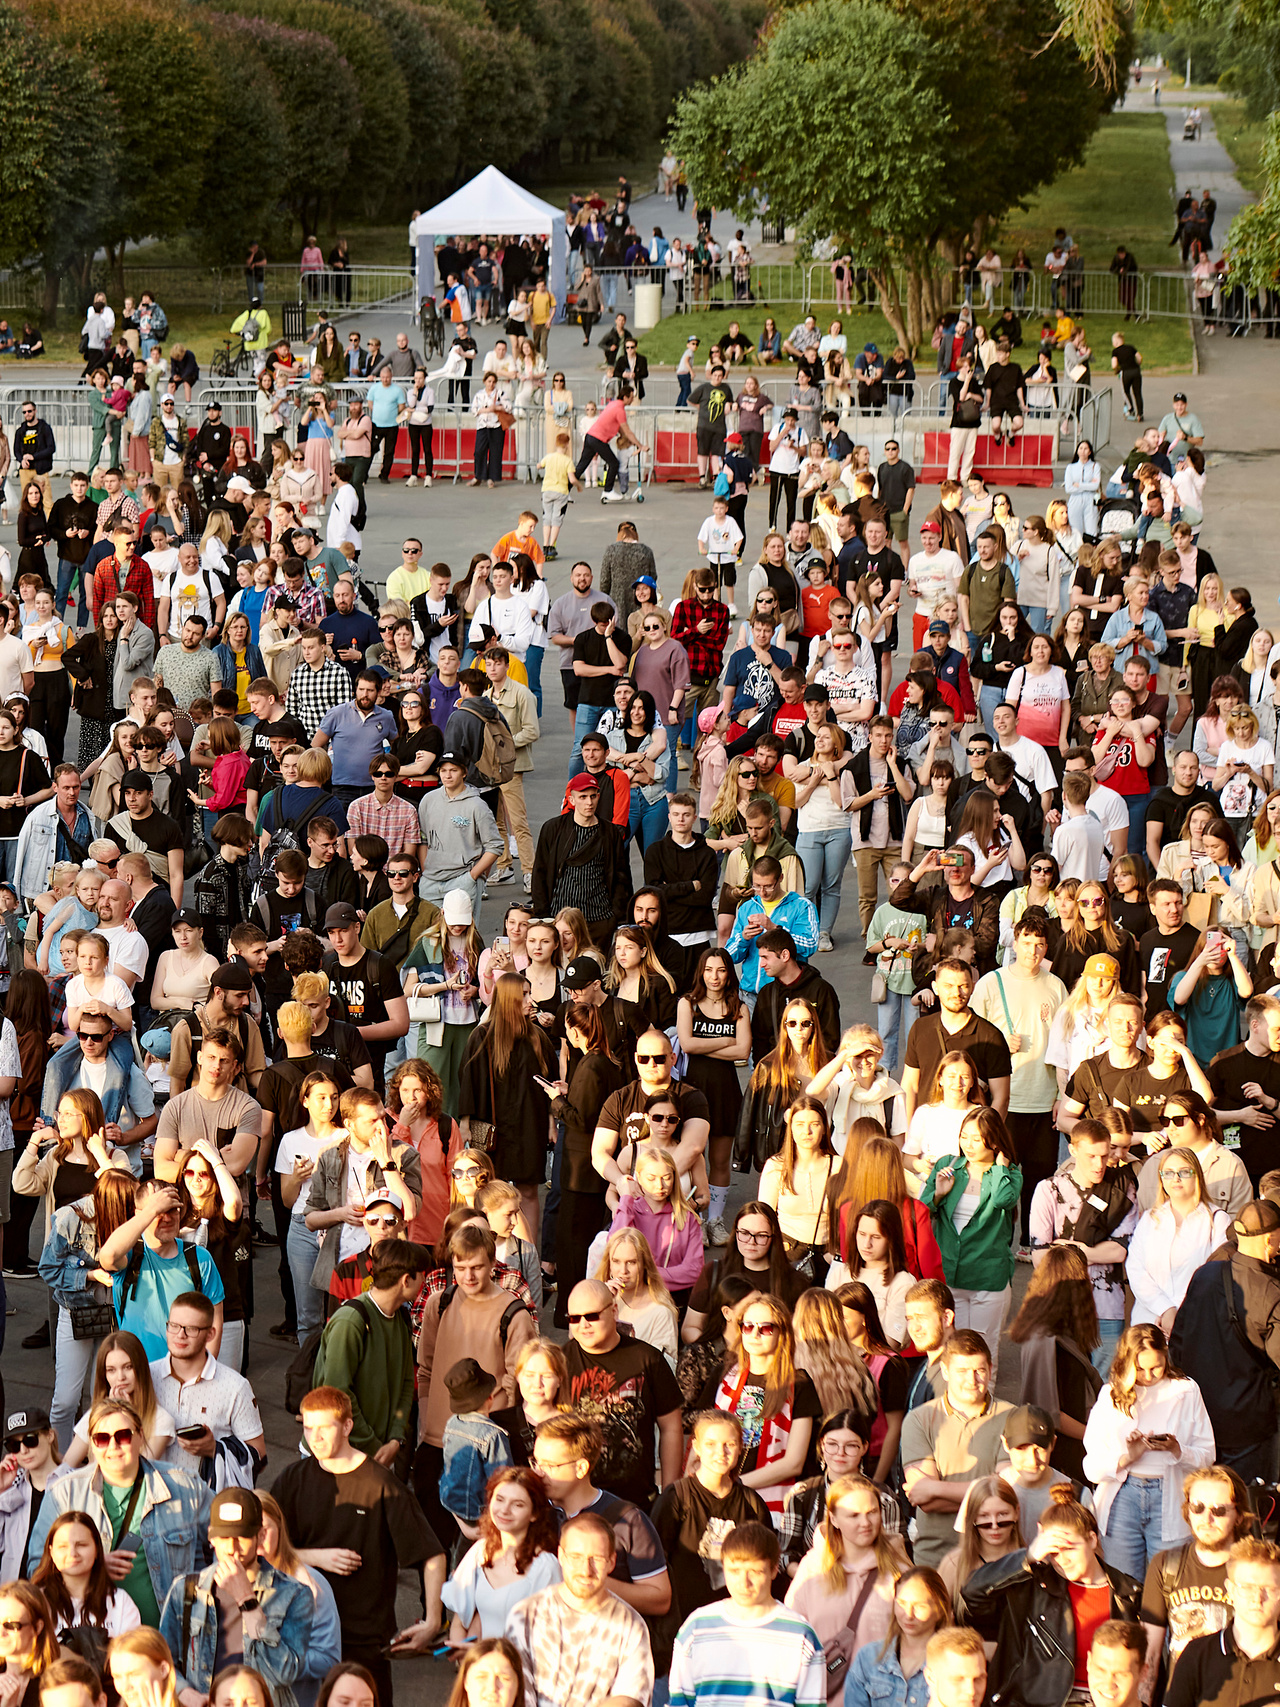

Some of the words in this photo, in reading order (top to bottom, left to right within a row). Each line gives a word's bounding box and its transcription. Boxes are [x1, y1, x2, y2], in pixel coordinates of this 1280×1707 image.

[829, 690, 854, 698] CONFLICT
[1033, 697, 1059, 707] SUNNY
[693, 1021, 734, 1034] J'ADORE
[1170, 1586, 1234, 1607] ПИВОЗА
